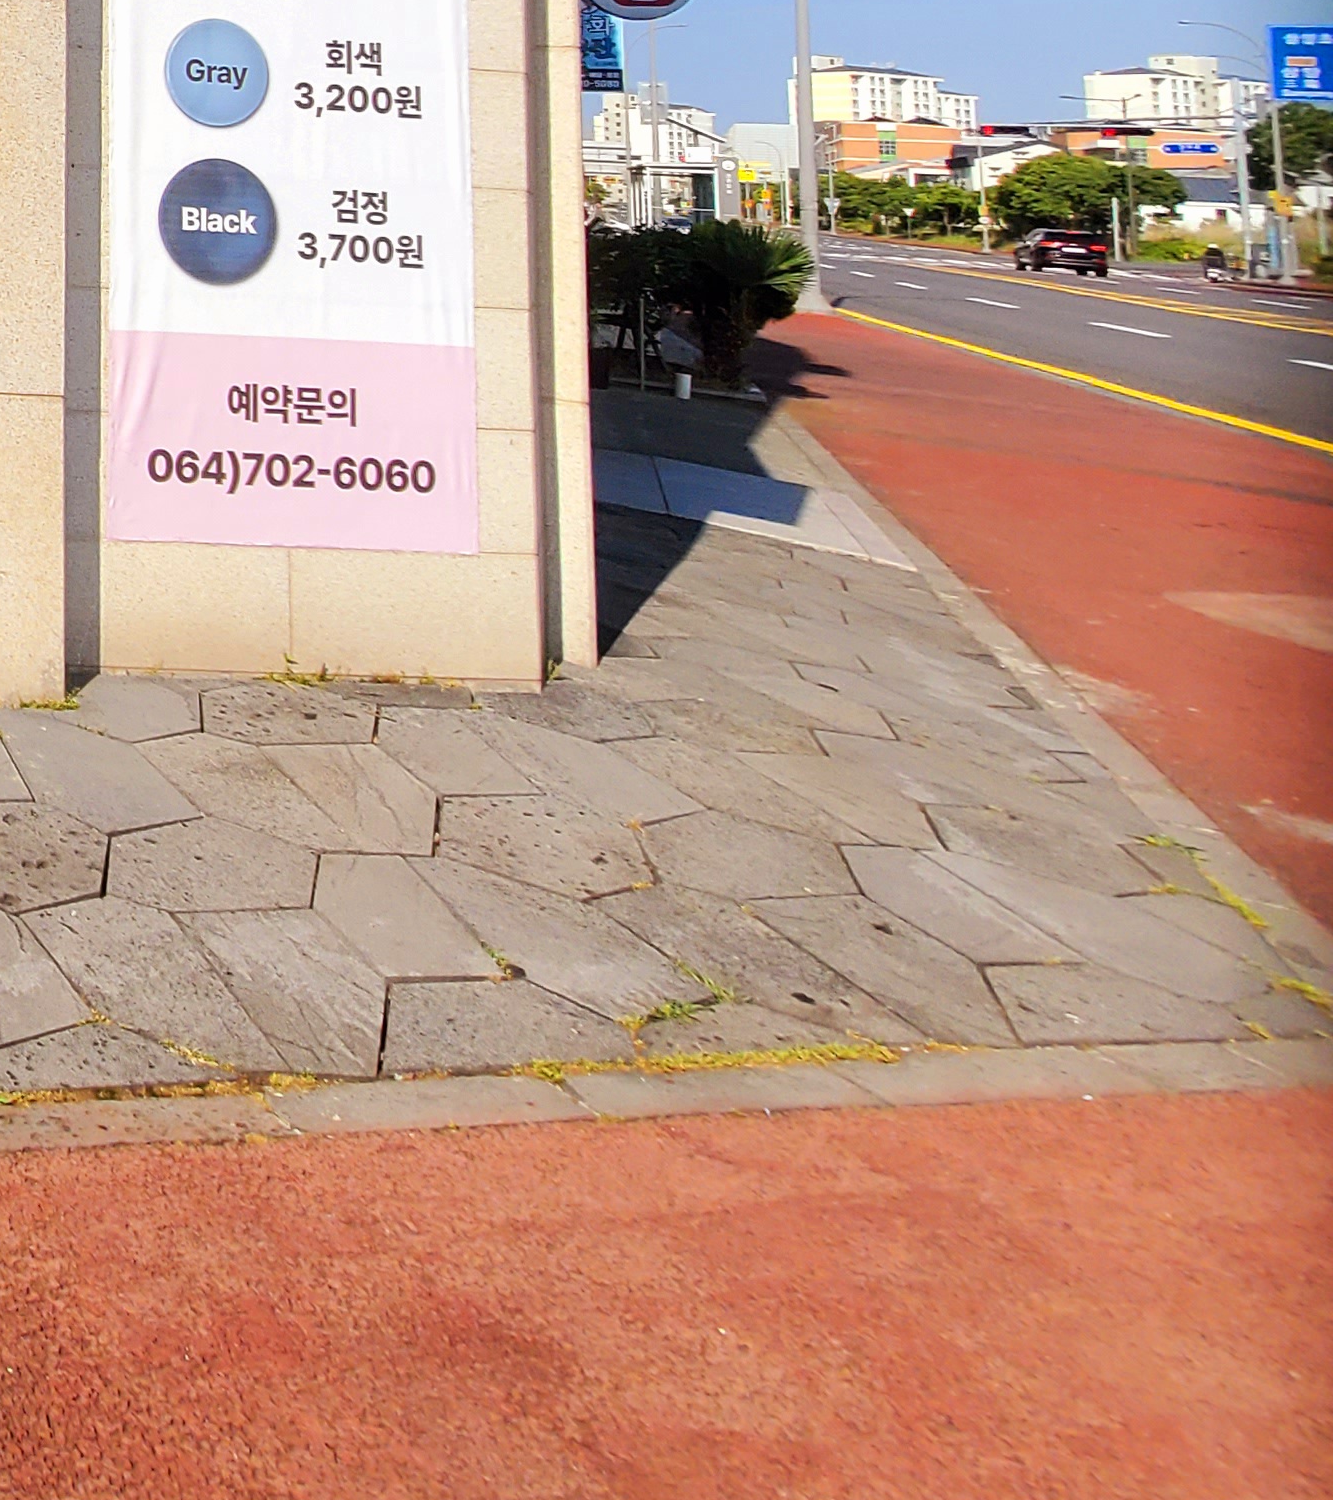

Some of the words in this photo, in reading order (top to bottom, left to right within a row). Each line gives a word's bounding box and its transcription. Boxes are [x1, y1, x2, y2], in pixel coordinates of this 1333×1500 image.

[185, 58, 248, 91] Gray
[325, 40, 384, 77] 회색
[293, 82, 424, 121] 3,200원
[180, 205, 258, 236] Black
[331, 189, 390, 226] 검정
[296, 232, 425, 270] 3,700원
[226, 382, 359, 427] 예약문의
[146, 448, 436, 496] 064)702-6060
